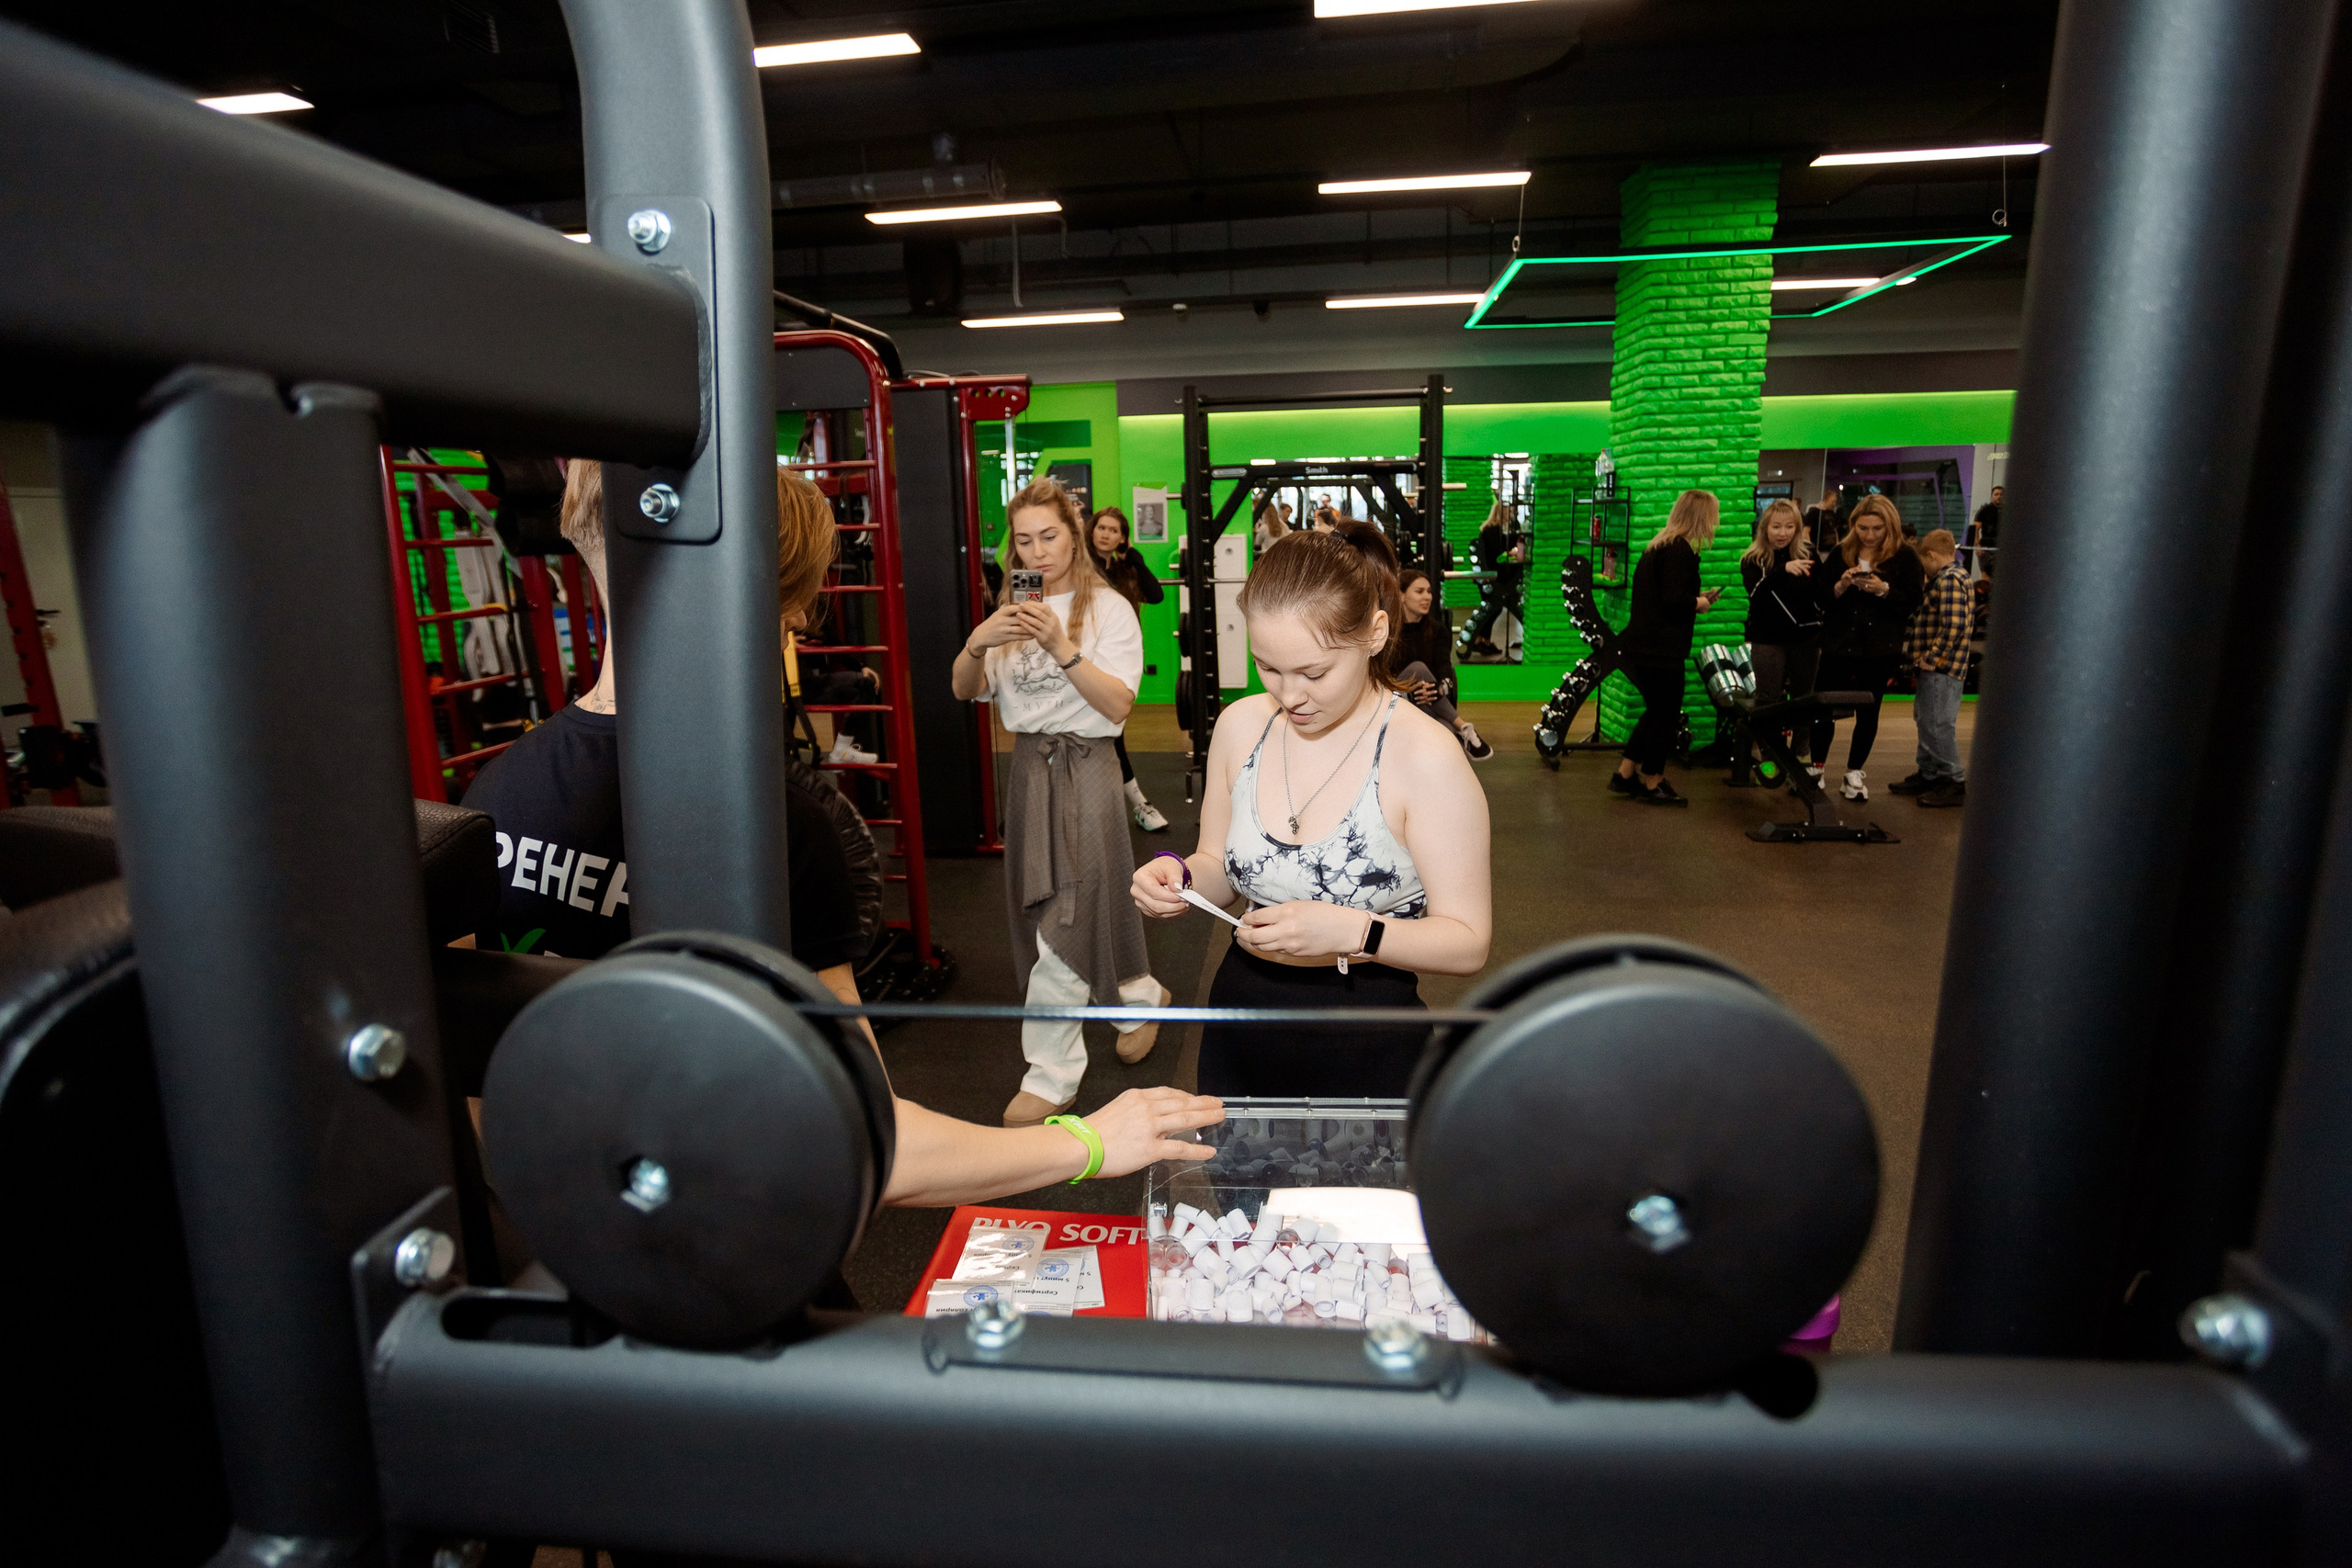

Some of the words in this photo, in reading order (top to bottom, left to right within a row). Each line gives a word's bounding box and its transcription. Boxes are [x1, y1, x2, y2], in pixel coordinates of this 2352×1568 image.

[1305, 466, 1329, 475] Smith
[1058, 1224, 1147, 1246] SOFT
[1013, 1288, 1058, 1296] Сертификат
